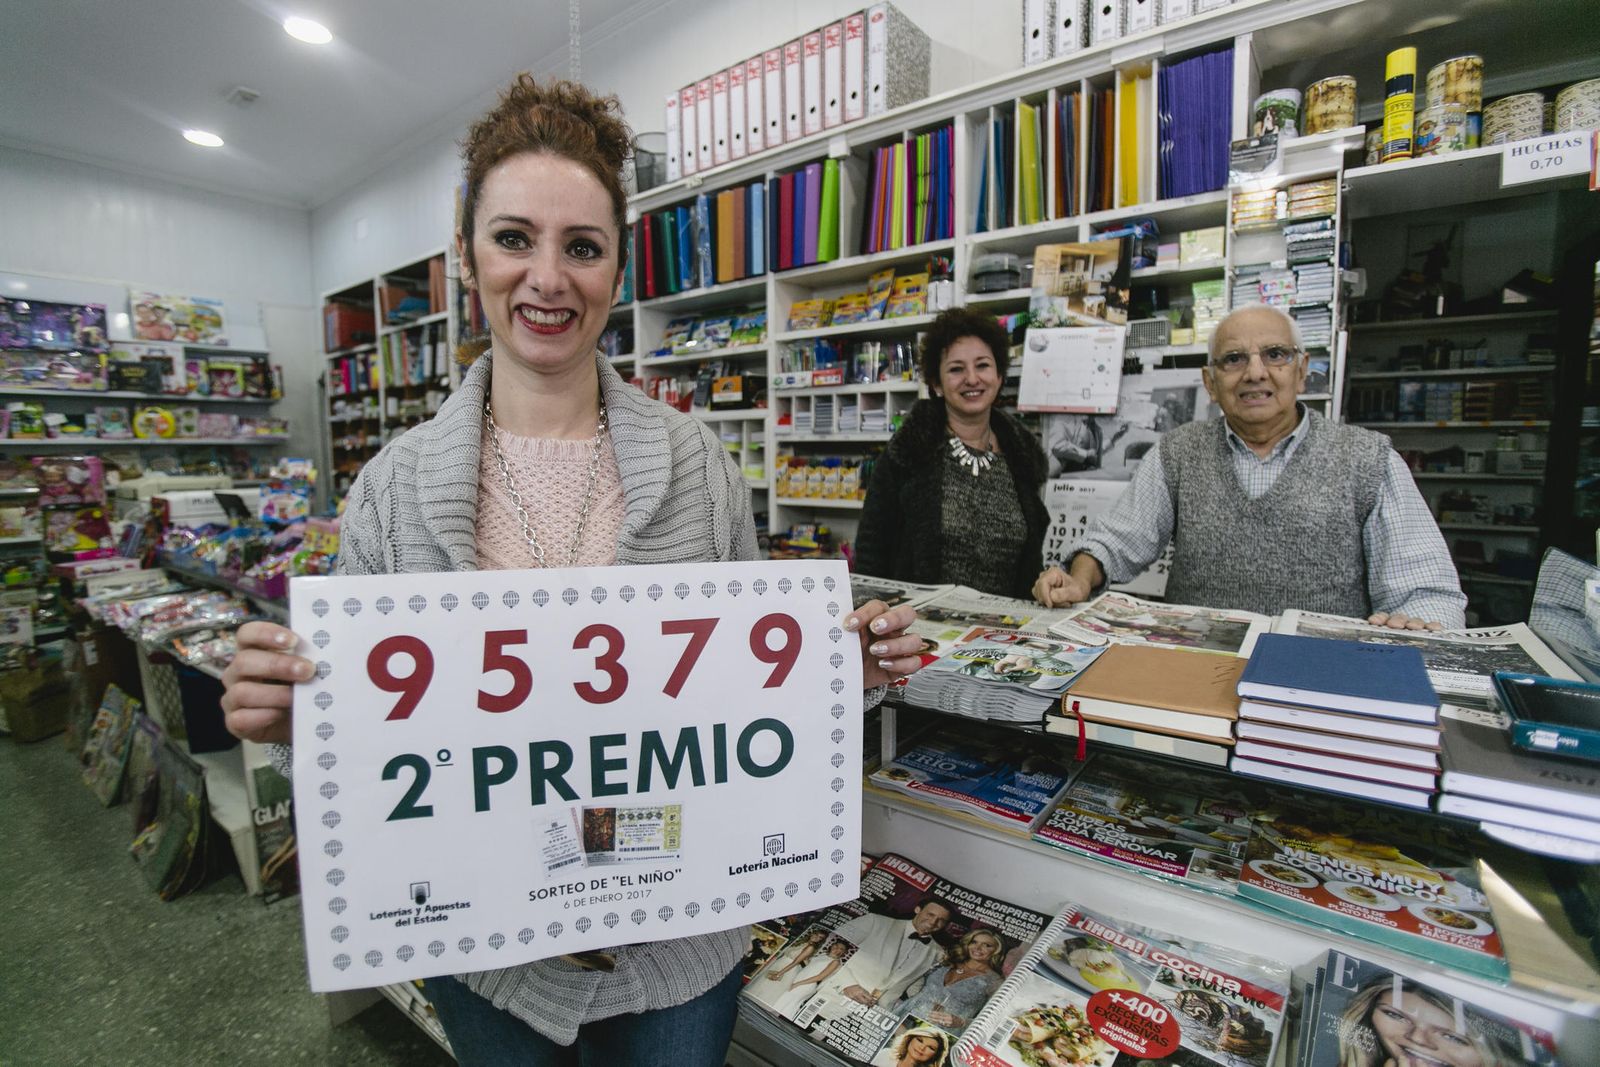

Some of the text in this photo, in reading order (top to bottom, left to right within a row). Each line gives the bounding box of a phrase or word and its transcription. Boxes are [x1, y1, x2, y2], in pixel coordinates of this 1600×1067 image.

[1511, 138, 1583, 157] HUCHAS
[1053, 483, 1075, 492] julio
[1053, 526, 1066, 536] 10
[1059, 514, 1087, 525] 3 4
[1047, 551, 1061, 562] 24
[1050, 538, 1063, 549] 17
[472, 717, 795, 813] PREMIO
[1078, 815, 1127, 833] IDEAS
[1046, 819, 1178, 861] PARA RENOVAR
[728, 849, 819, 876] Lotería Nacional
[883, 856, 932, 885] ¡HOLA!
[528, 868, 682, 902] SORTEO DE "EL NIÑO"
[1248, 878, 1315, 903] DE LA ABUELA
[1380, 872, 1446, 894] MUY
[369, 901, 471, 921] Loterías y Apuestas
[563, 889, 653, 910] 6 DE ENERO 2017
[934, 889, 946, 899] DE
[1005, 916, 1041, 932] ESCASSI
[936, 880, 1044, 925] LA BODA SORPRESA
[1328, 902, 1361, 917] PLATO
[1339, 901, 1386, 918] IDEAS DE
[395, 913, 449, 928] del Estado
[1082, 919, 1242, 993] ¡HOLA! cocina
[1181, 971, 1267, 1010] invierno
[1106, 1002, 1163, 1034] RECETAS
[1107, 990, 1168, 1025] +400
[1093, 1005, 1170, 1048] EXCLUSIVAS
[1105, 1020, 1148, 1047] nuevas y
[1099, 1026, 1146, 1055] originales
